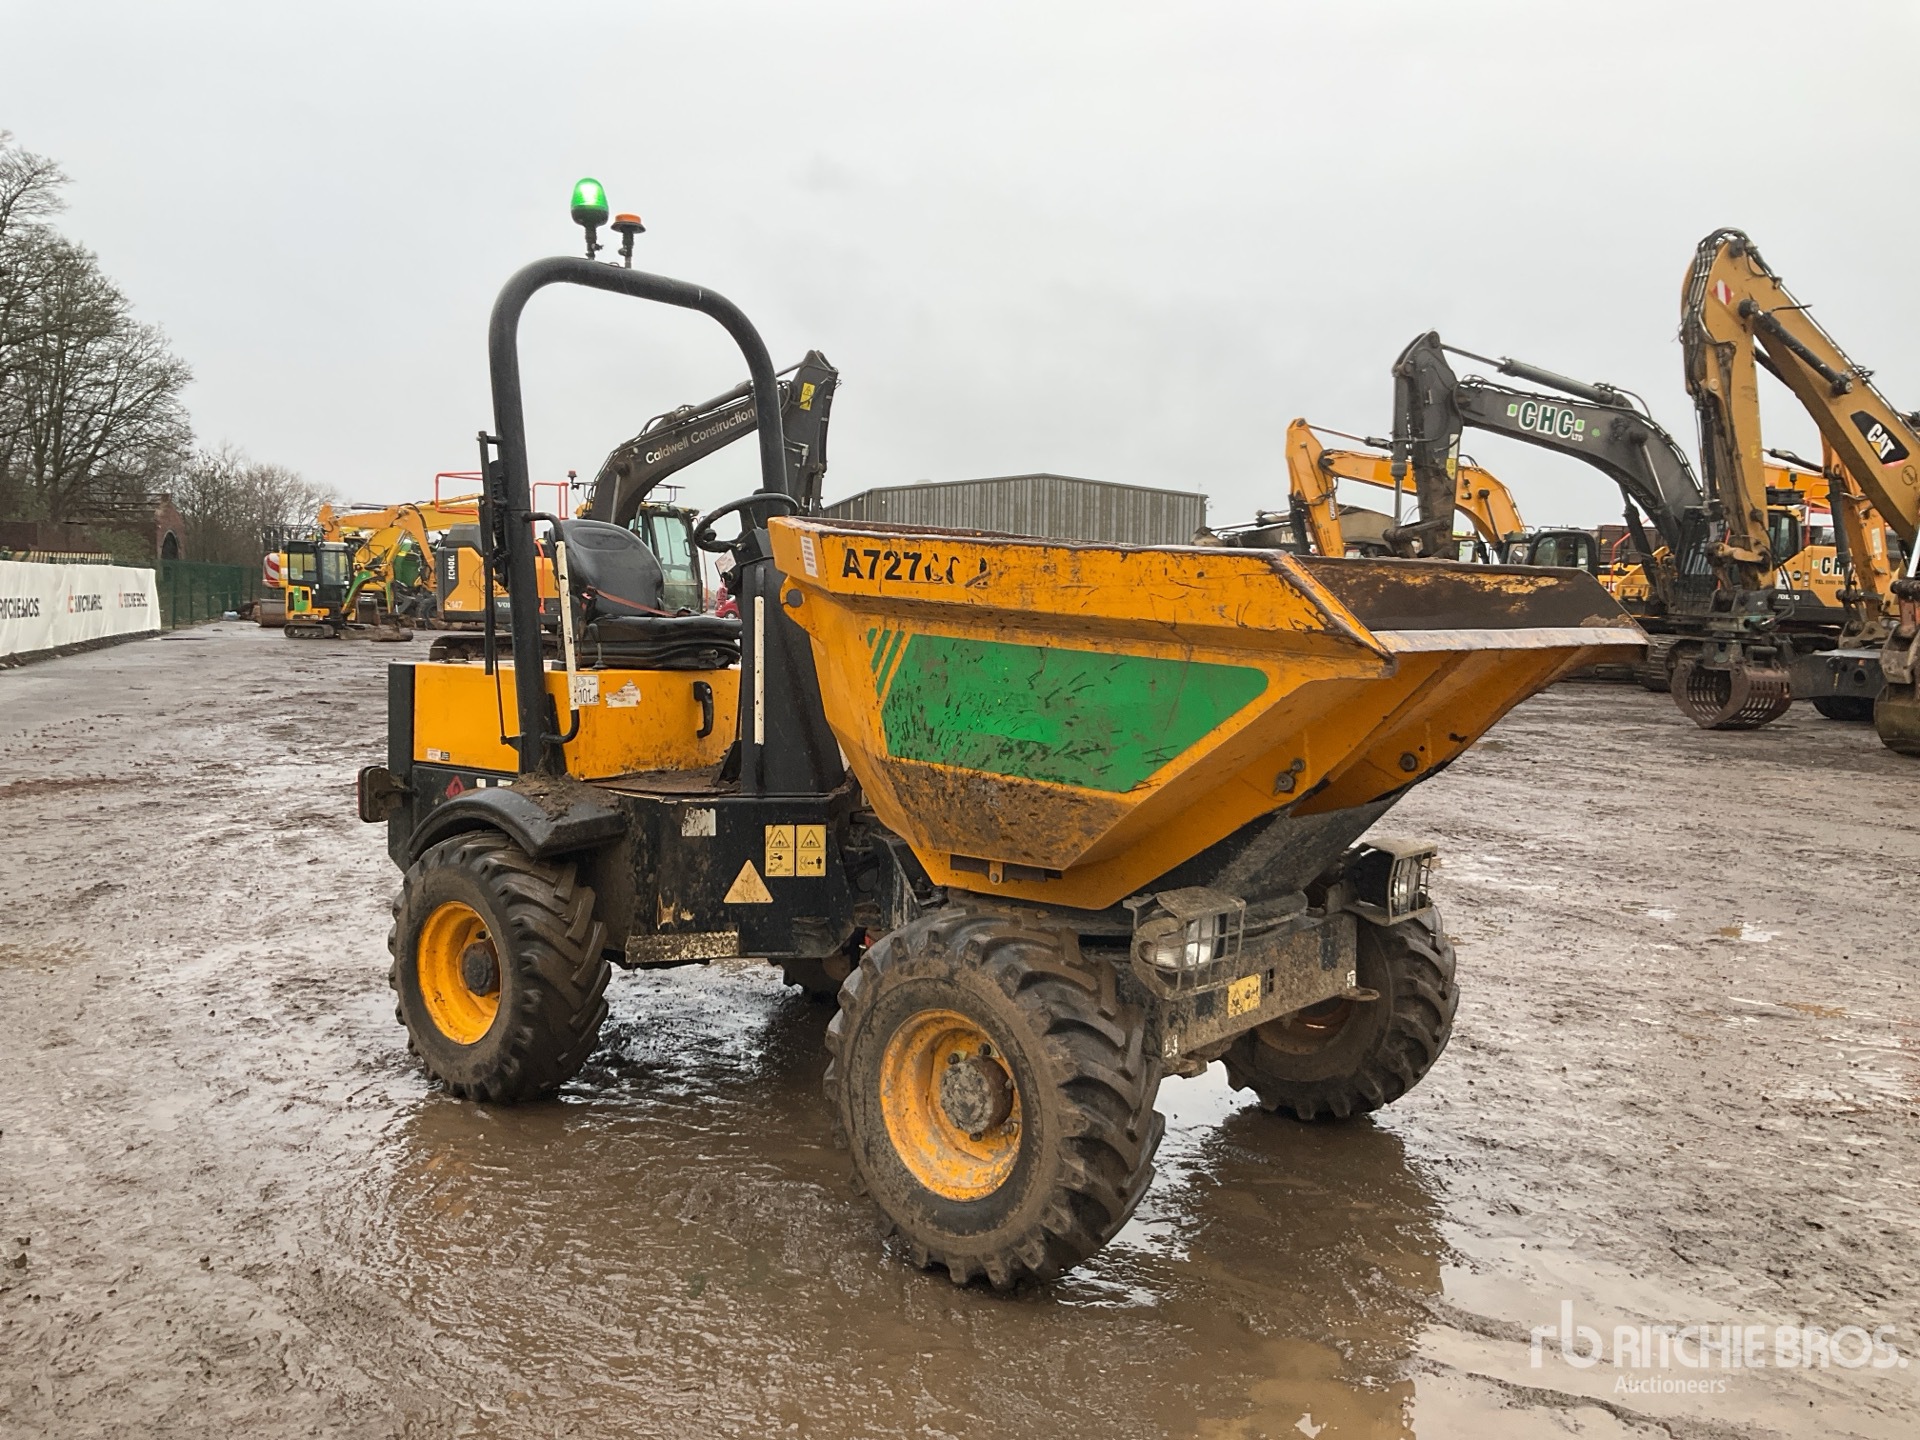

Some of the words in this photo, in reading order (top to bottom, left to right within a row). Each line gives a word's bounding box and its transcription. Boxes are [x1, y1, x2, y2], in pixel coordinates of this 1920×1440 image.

[645, 436, 689, 464] Caldwell
[690, 408, 755, 444] Construction
[1518, 401, 1575, 438] CHC
[1571, 433, 1584, 442] LTD
[1867, 423, 1895, 459] CAT
